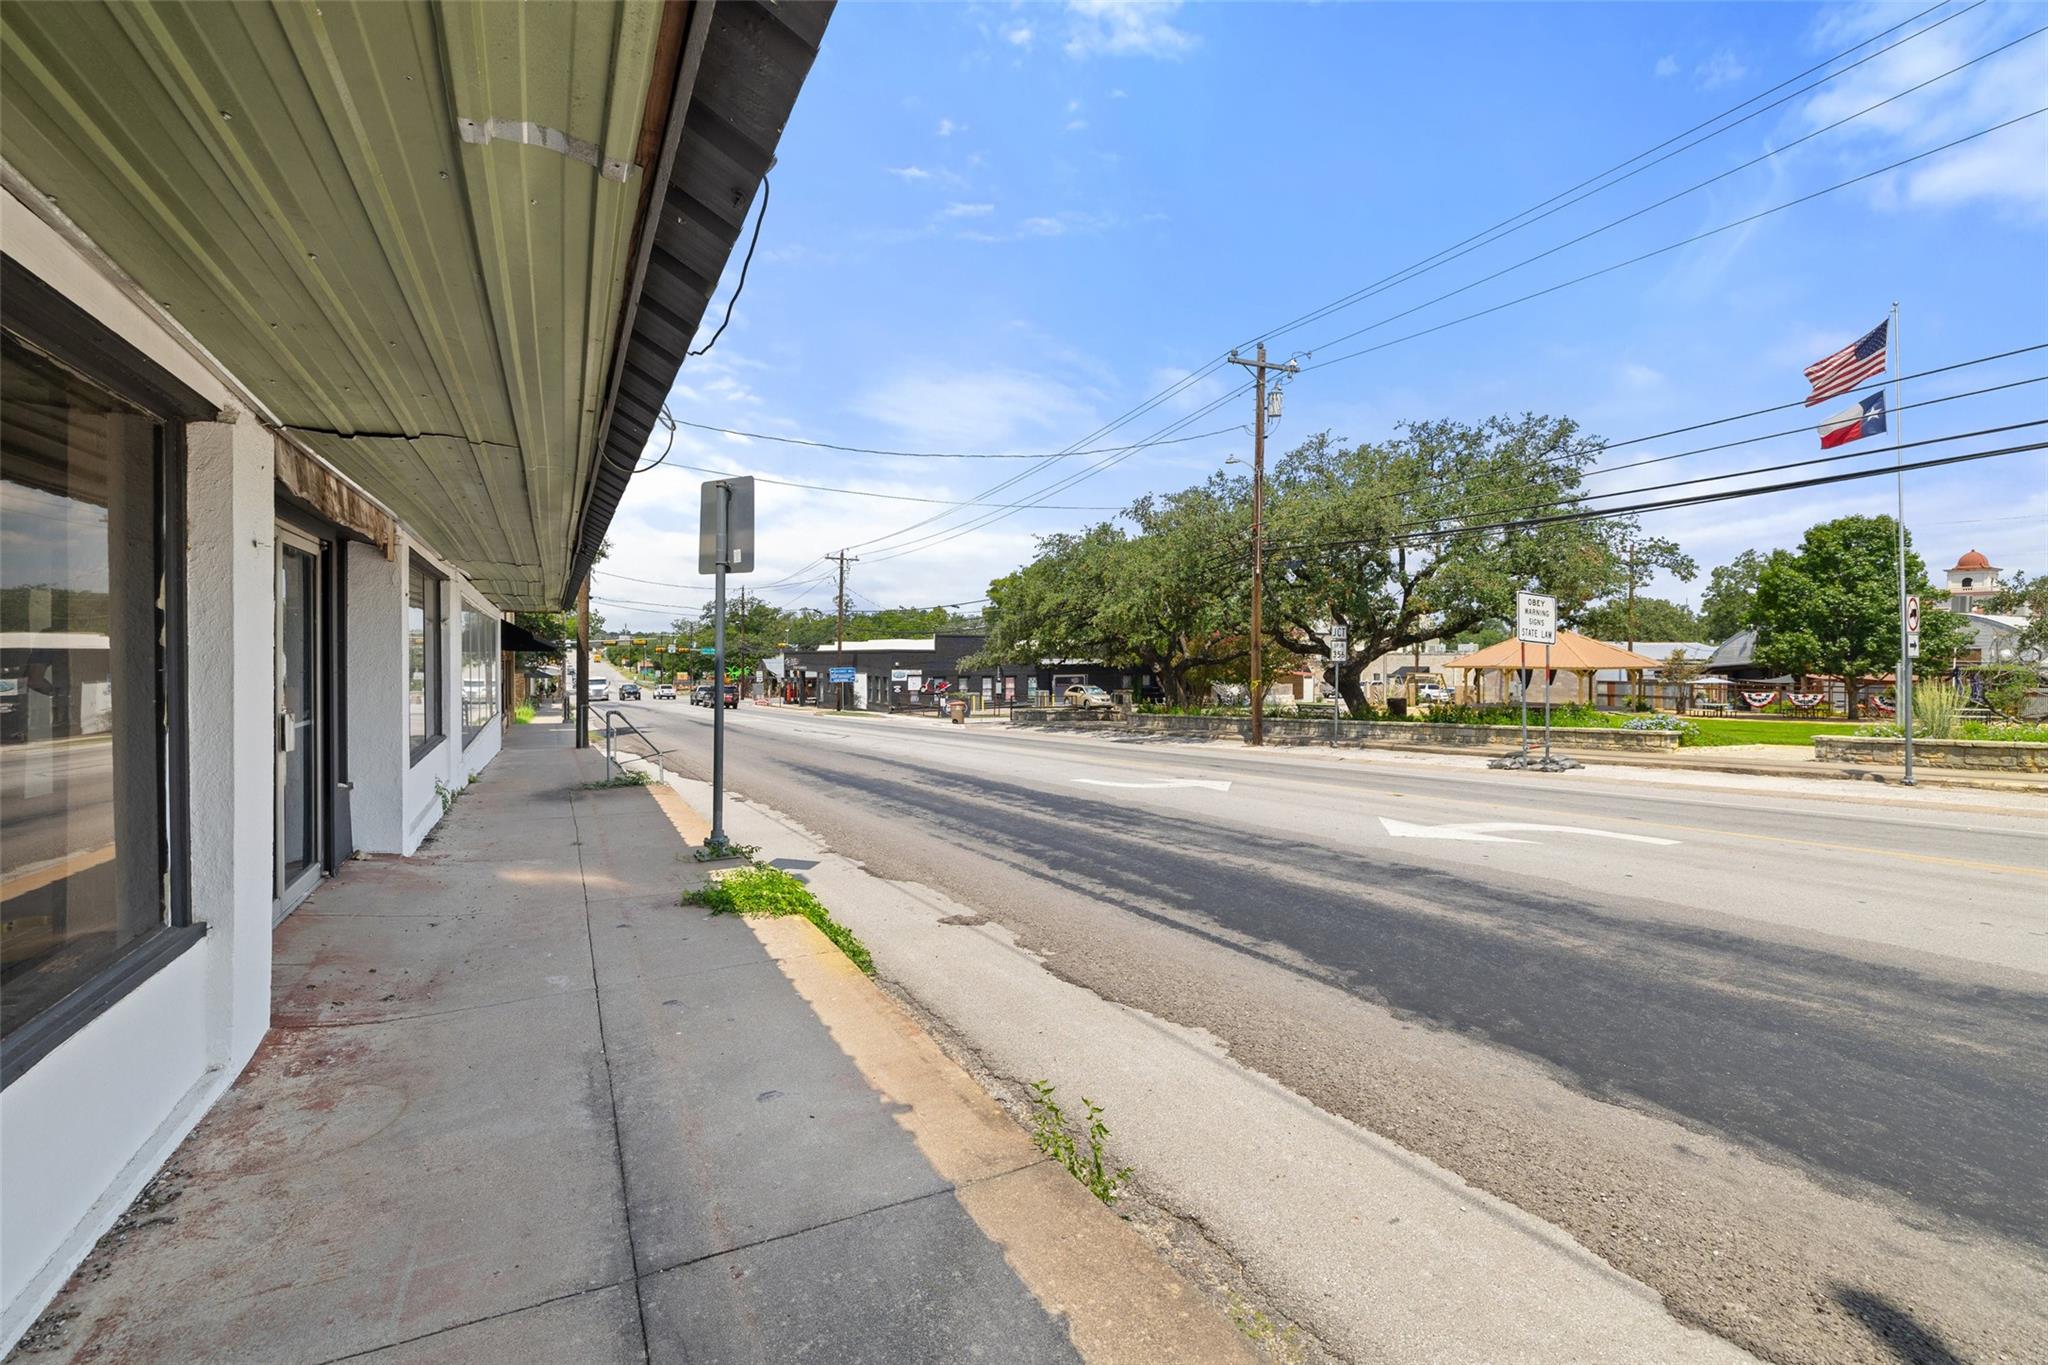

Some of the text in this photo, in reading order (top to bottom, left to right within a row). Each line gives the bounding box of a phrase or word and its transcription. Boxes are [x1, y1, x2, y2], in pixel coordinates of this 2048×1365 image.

[1527, 598, 1545, 607] OBEY
[1525, 608, 1550, 617] WARNING
[1529, 617, 1545, 627] SIGNS
[1333, 627, 1345, 637] JCT
[1521, 627, 1552, 639] STATE LAW
